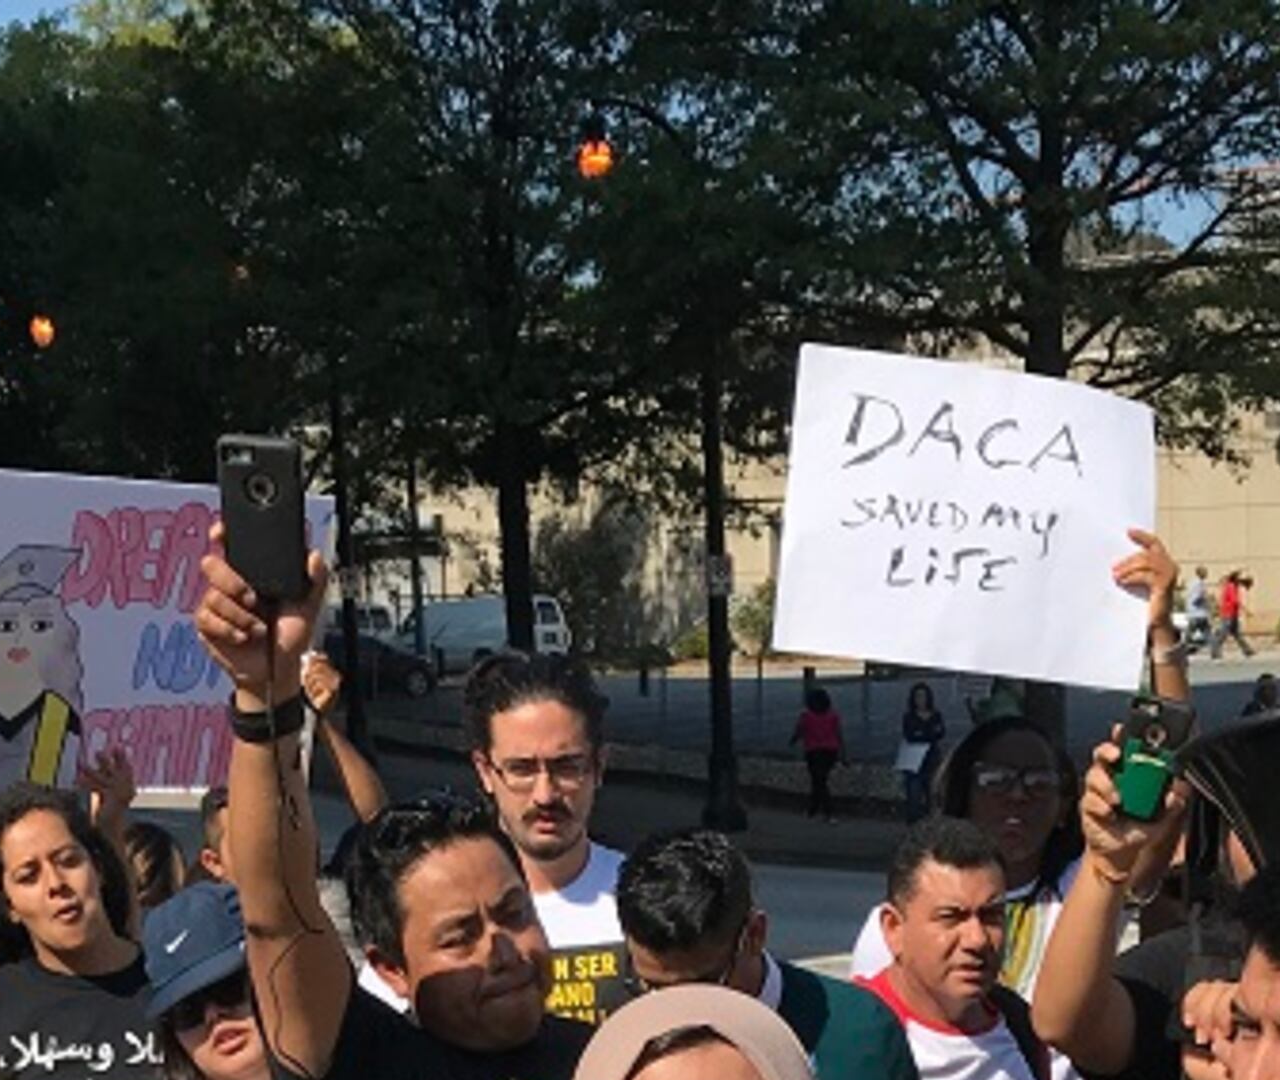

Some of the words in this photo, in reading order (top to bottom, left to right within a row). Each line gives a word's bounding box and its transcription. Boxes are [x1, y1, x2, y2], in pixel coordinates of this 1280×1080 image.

[842, 393, 1082, 477] DACA
[840, 494, 969, 534] SAVED
[981, 503, 1058, 559] MY
[574, 952, 618, 979] SER
